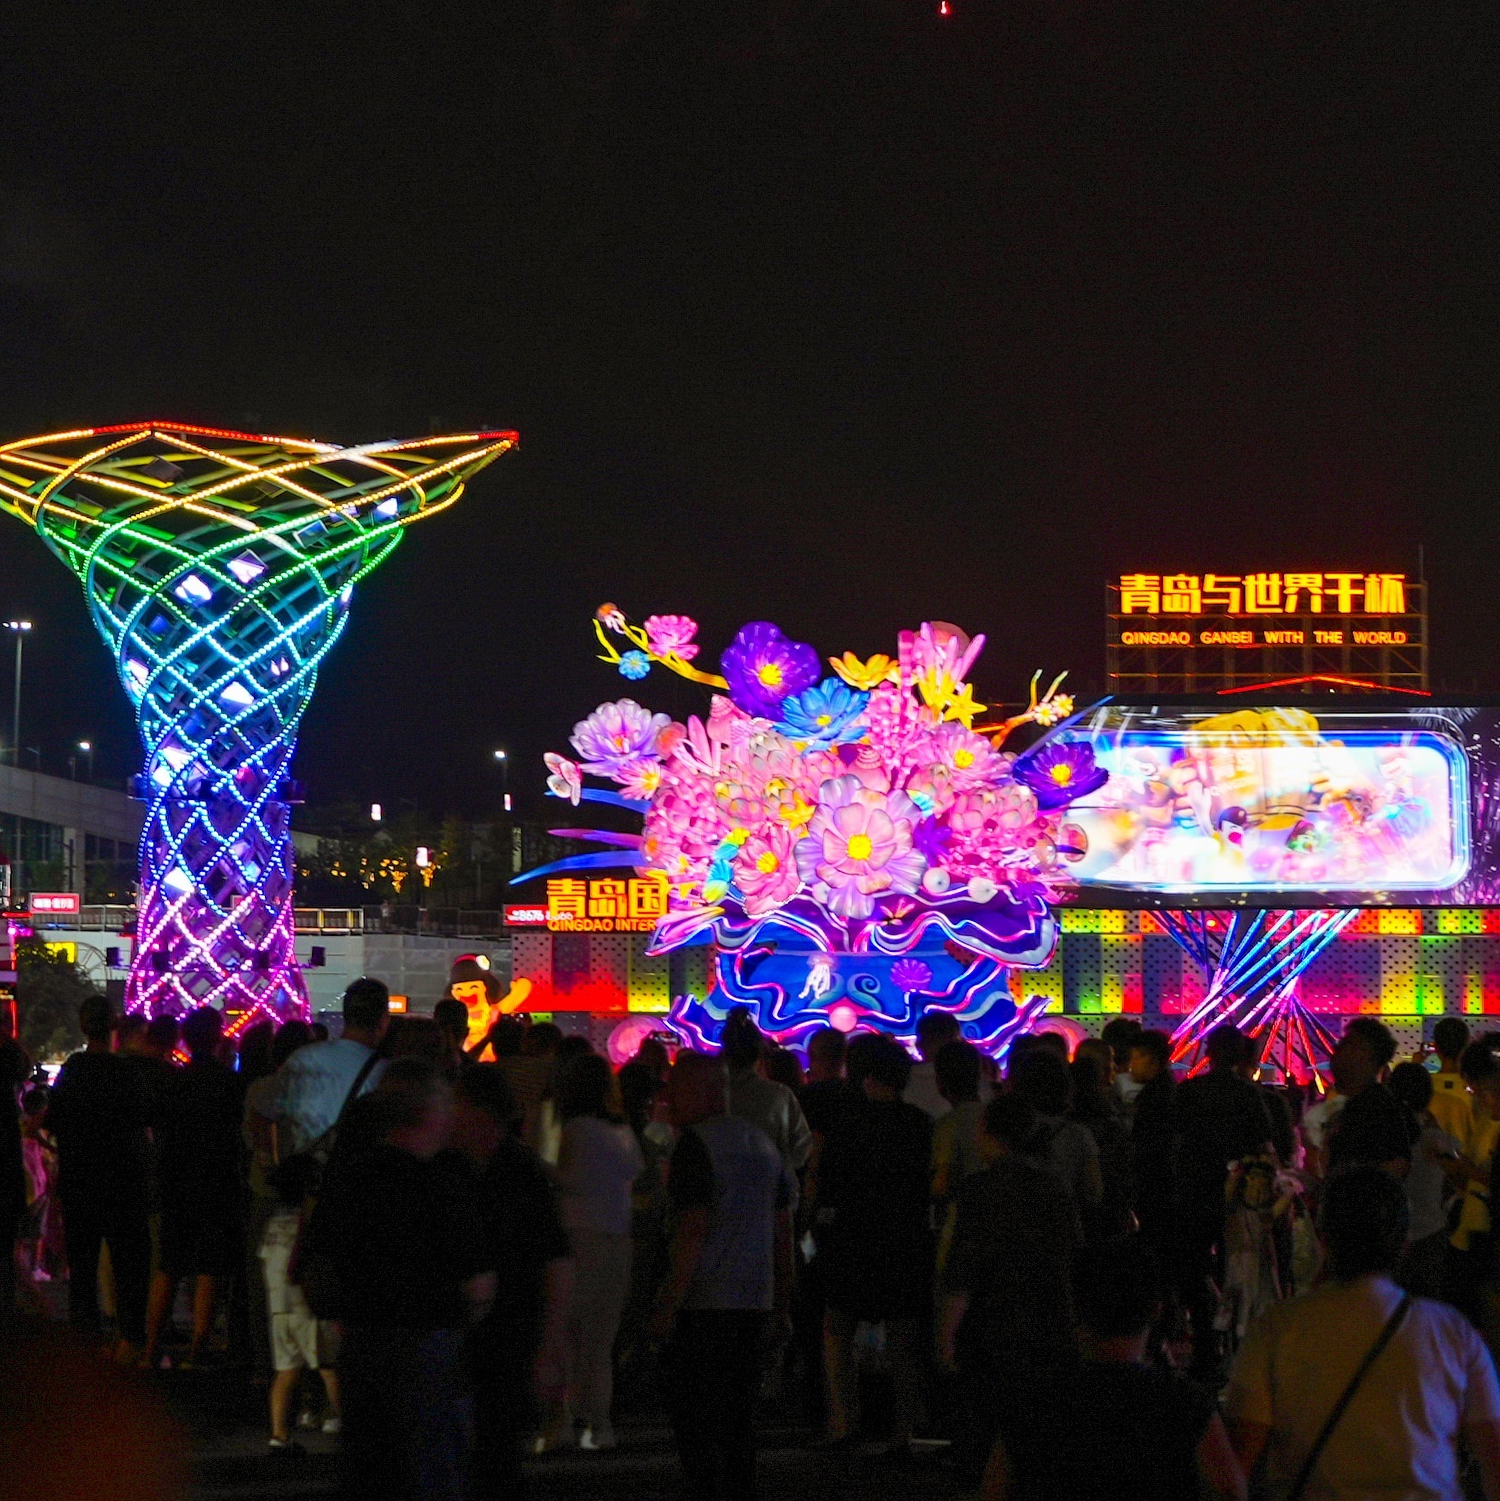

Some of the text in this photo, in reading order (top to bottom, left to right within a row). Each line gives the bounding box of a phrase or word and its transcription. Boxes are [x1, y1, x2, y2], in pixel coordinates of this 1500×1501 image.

[1119, 573, 1406, 614] 青岛与世界干杯
[1121, 631, 1407, 646] QINGDAO GANBEI WITH THE WORLD
[547, 878, 668, 918] 青岛国
[547, 919, 614, 932] QINGDAO
